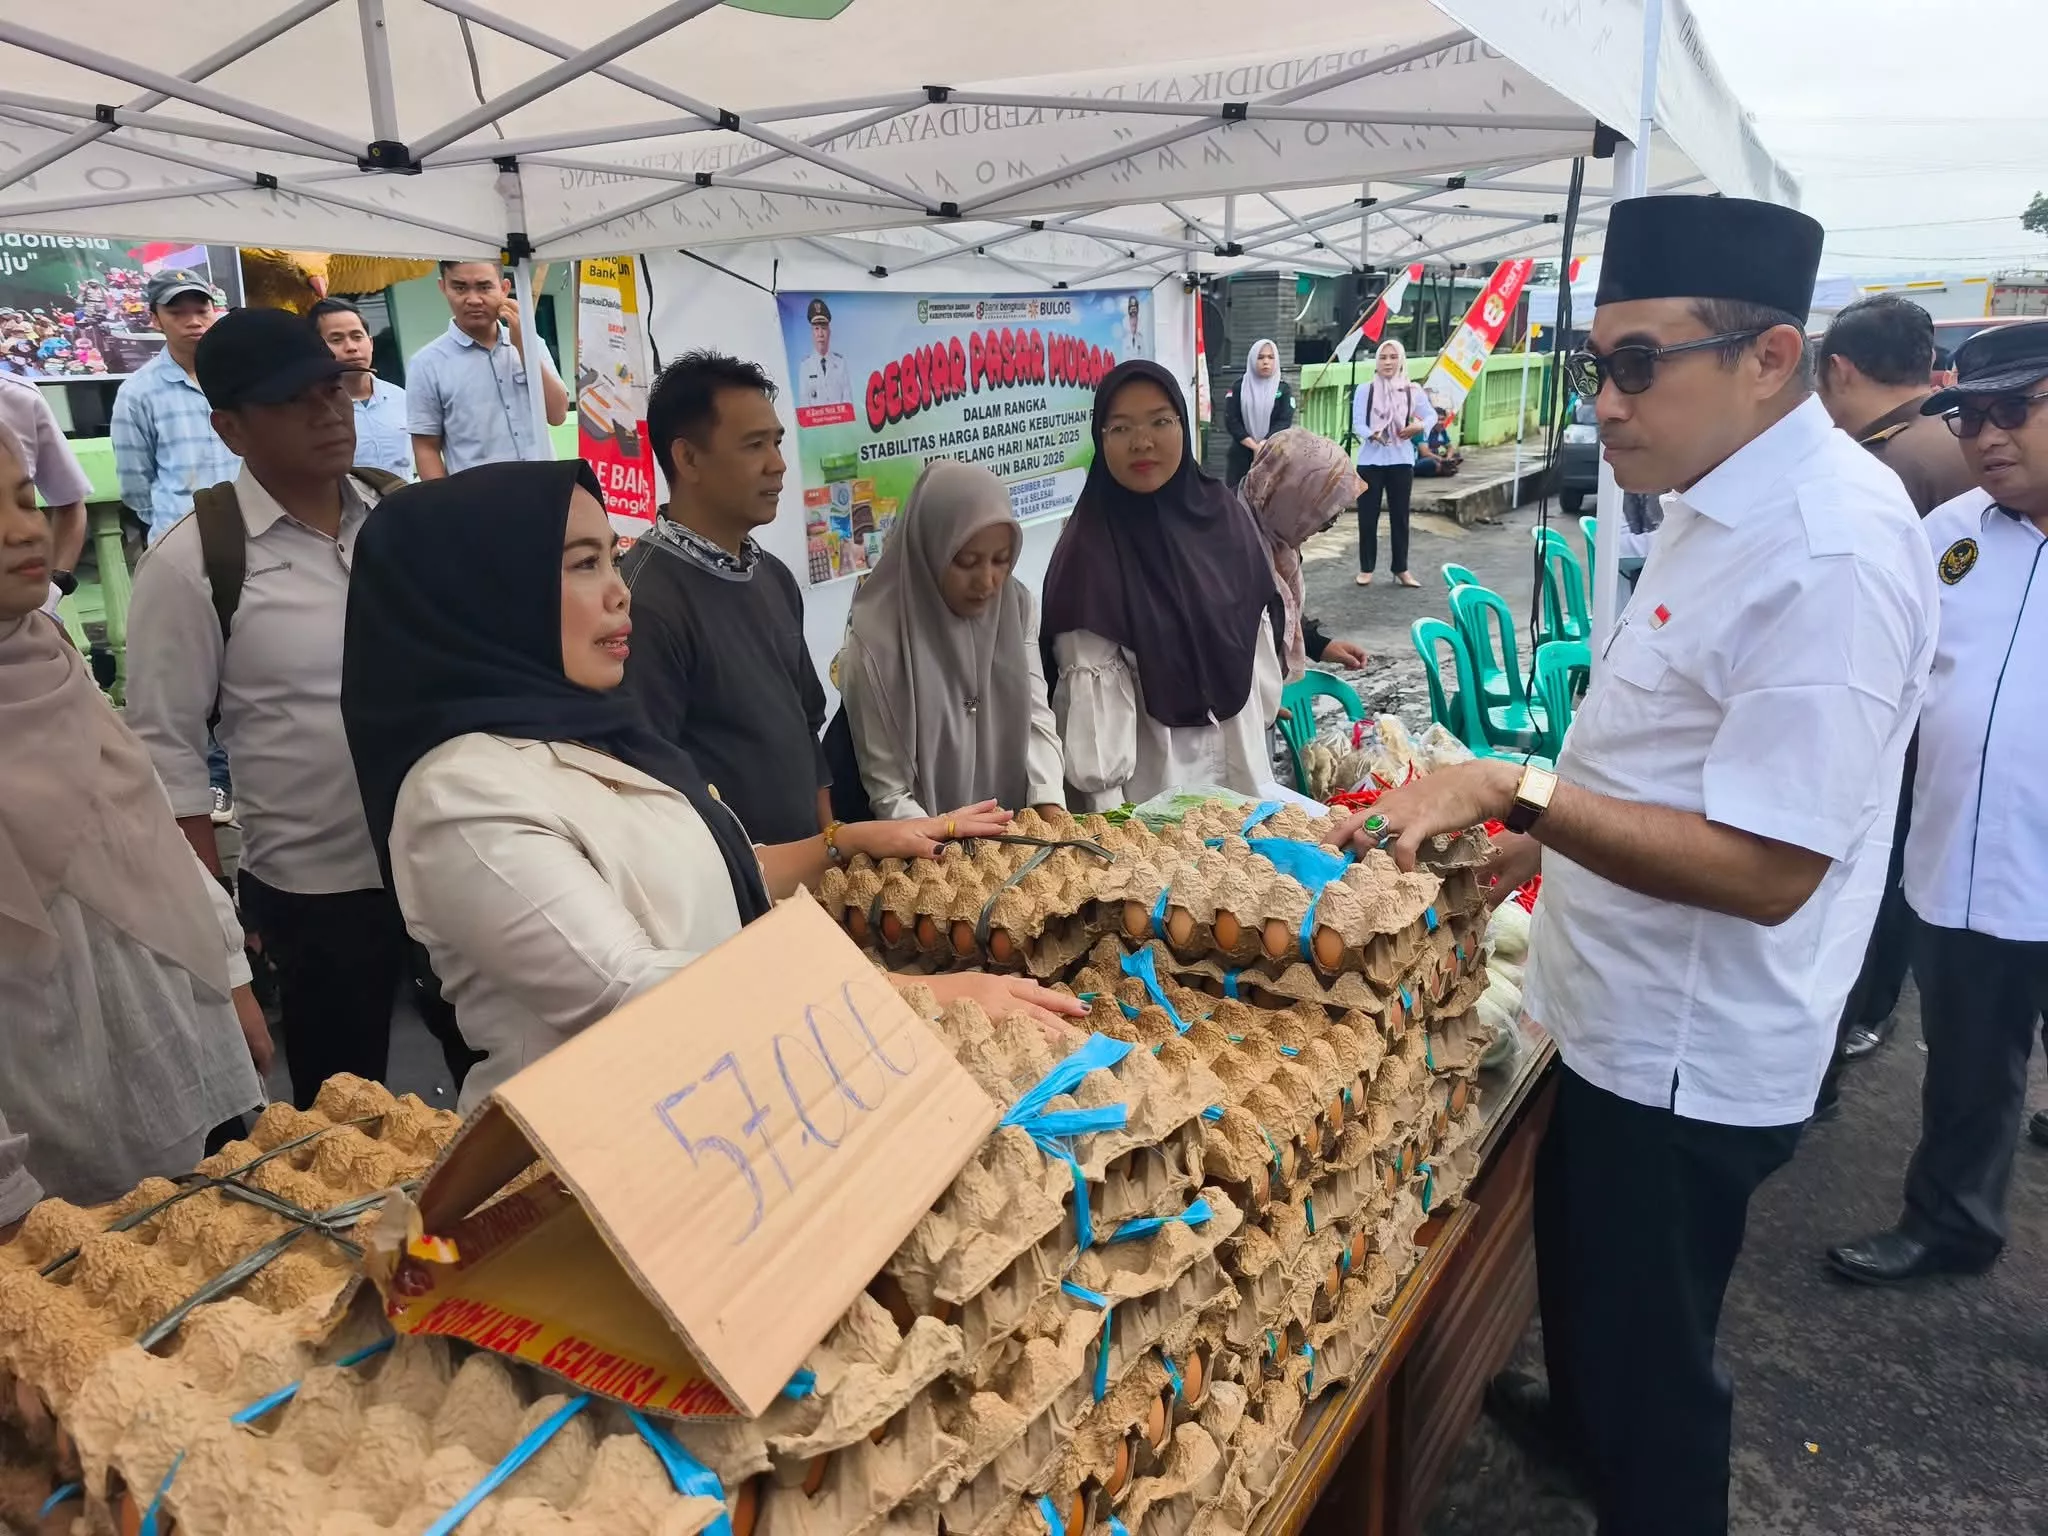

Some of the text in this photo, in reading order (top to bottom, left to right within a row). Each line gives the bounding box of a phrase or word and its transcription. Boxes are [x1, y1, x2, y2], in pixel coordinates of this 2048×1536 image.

[589, 265, 617, 281] Bank
[1040, 301, 1071, 316] BULOG
[866, 336, 967, 434] GEBYAR
[969, 327, 1045, 394] PASAR
[963, 398, 1047, 422] DALAM RANGKA
[860, 435, 936, 461] STABILITAS
[939, 427, 979, 447] HARGA
[983, 419, 1026, 440] BARANG
[1029, 412, 1087, 432] KEBUTUHAN
[998, 441, 1023, 459] HARI
[1025, 435, 1056, 454] NATAL
[1058, 429, 1080, 445] 2025
[1013, 456, 1040, 474] BARU
[1043, 450, 1065, 467] 2026
